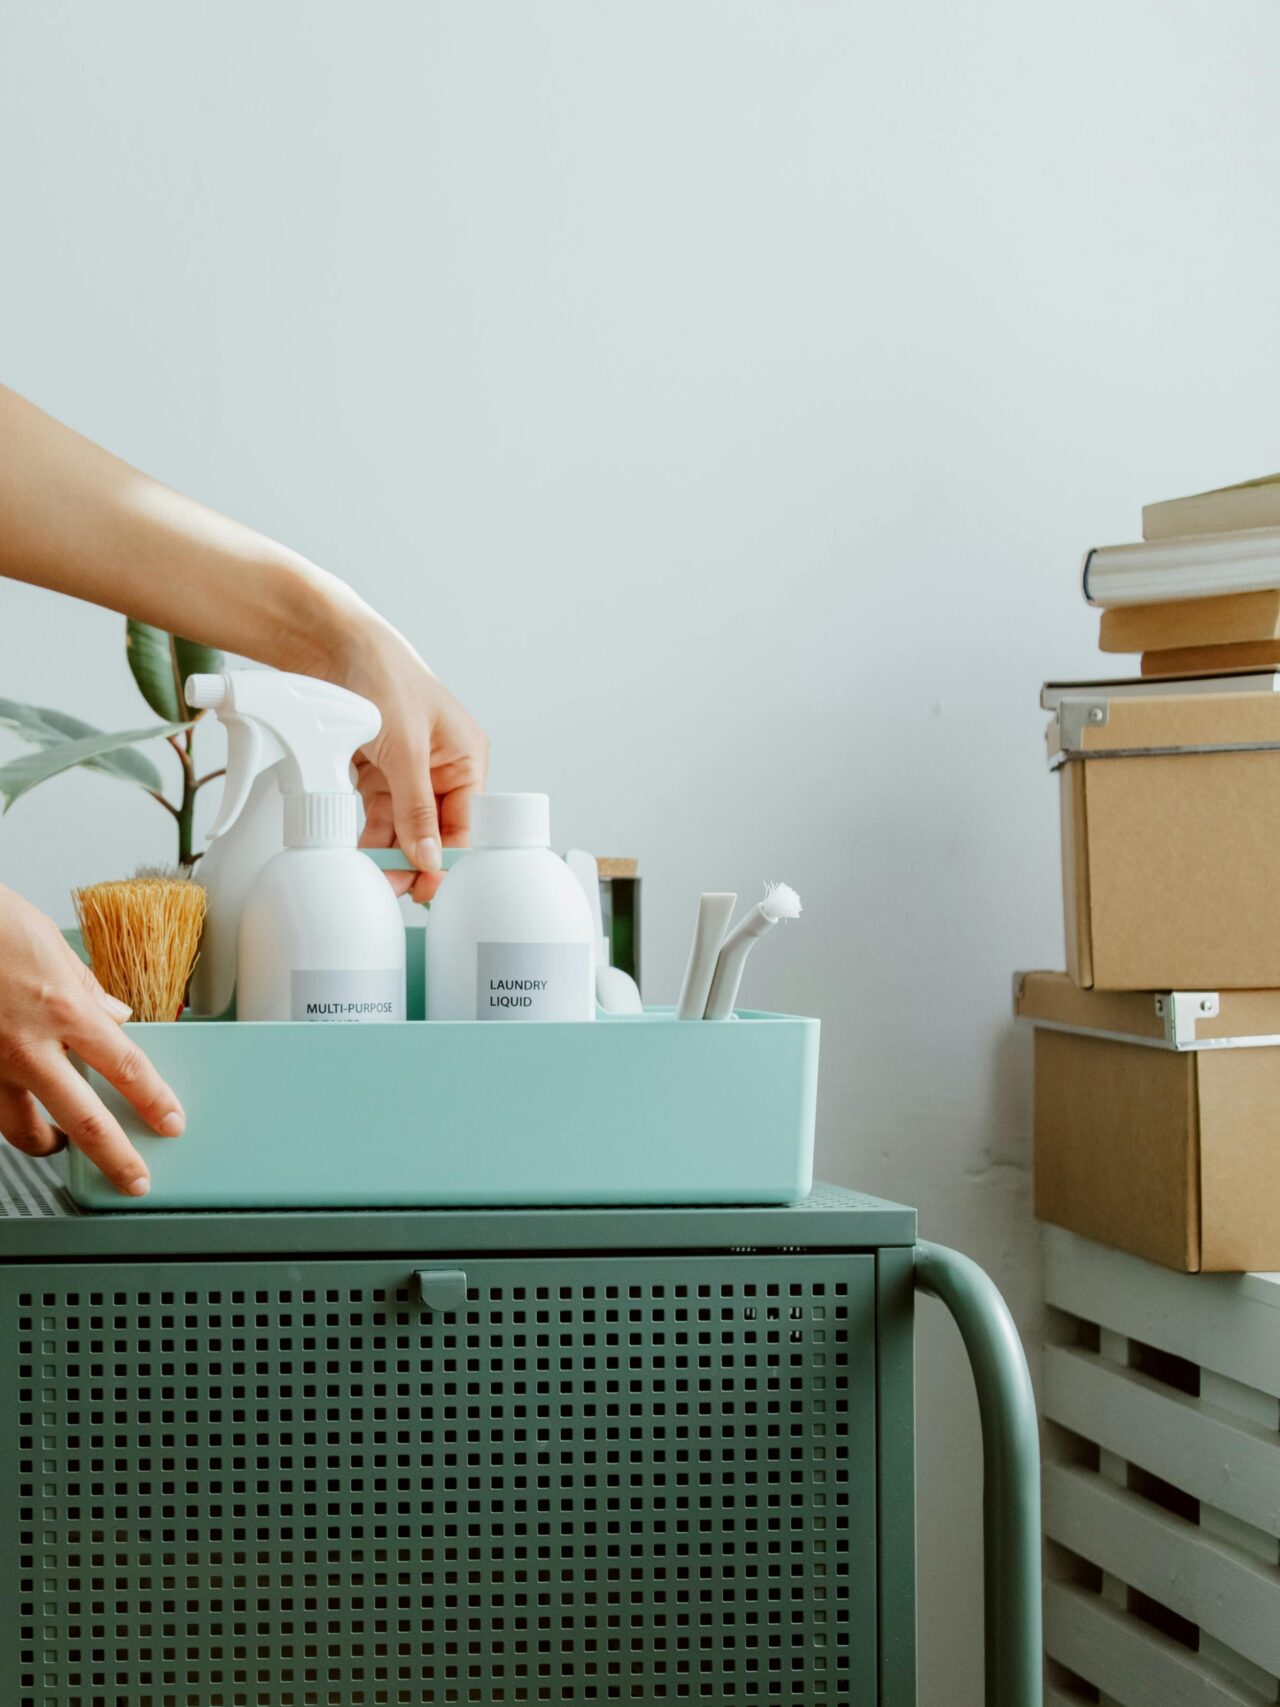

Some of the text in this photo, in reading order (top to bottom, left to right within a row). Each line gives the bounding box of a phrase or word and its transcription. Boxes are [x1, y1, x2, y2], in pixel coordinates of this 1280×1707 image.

[490, 979, 548, 991] LAUNDRY
[306, 1002, 393, 1014] MULTI-PURPOSE
[490, 996, 532, 1008] LIQUID
